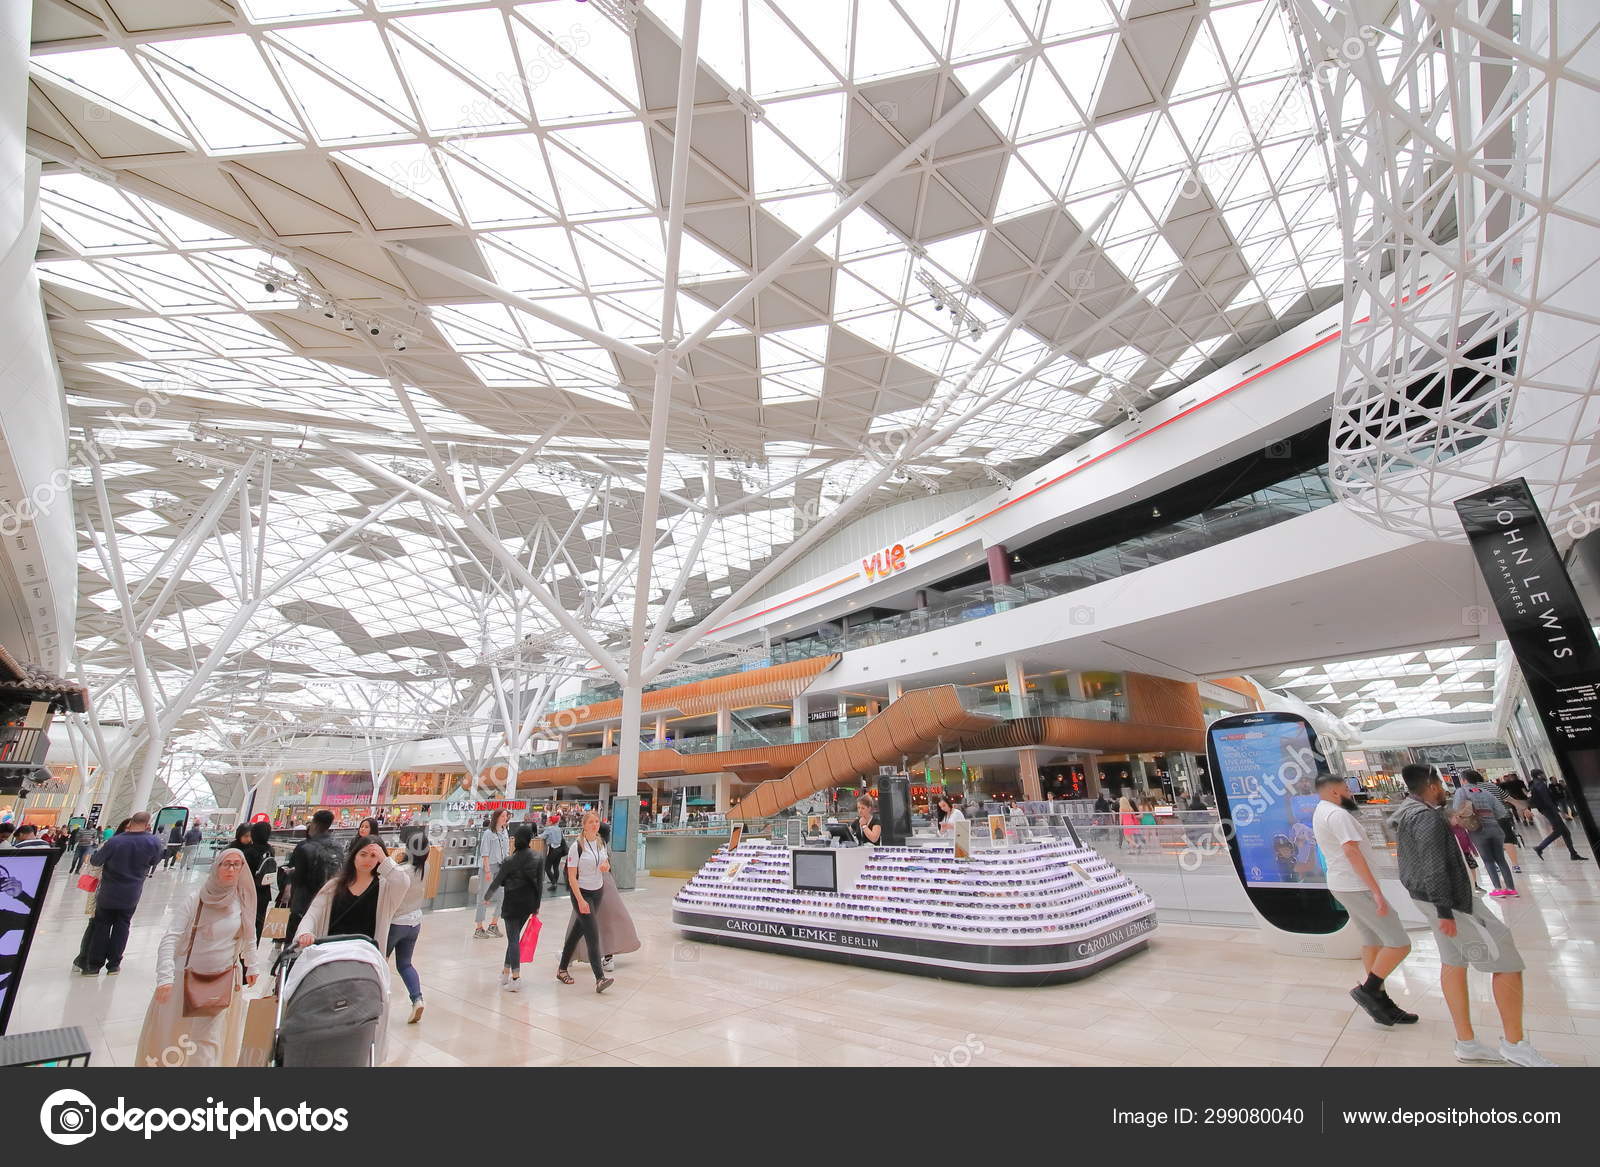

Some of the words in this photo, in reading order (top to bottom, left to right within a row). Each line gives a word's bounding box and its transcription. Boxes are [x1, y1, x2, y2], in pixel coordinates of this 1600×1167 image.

[1487, 499, 1533, 566] JOHN
[1523, 575, 1573, 659] LEWIS
[1497, 559, 1527, 615] PARTNERS
[1231, 775, 1259, 795] £10
[448, 801, 476, 811] TAPAS
[726, 919, 787, 936] CAROLINA
[791, 927, 837, 943] LEMKE
[841, 935, 879, 948] BERLIN
[1078, 930, 1125, 956] CAROLINA
[1125, 919, 1150, 938] LEMKE
